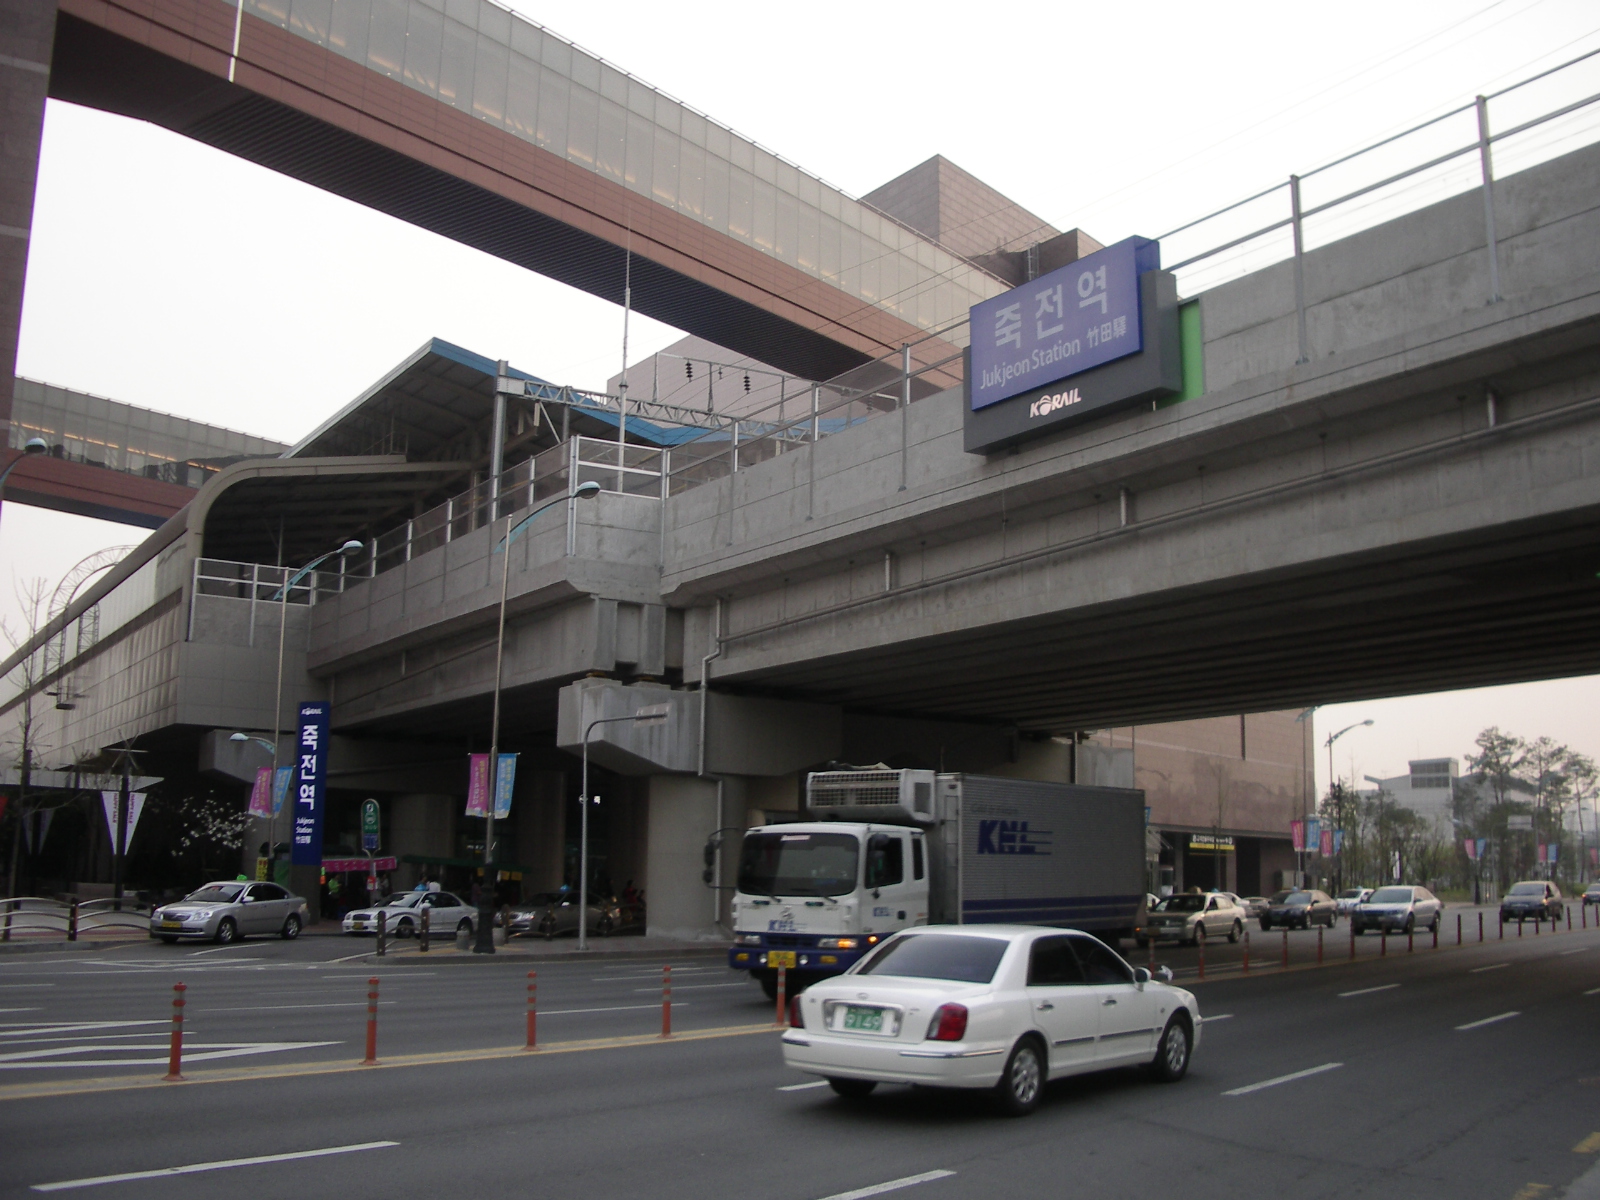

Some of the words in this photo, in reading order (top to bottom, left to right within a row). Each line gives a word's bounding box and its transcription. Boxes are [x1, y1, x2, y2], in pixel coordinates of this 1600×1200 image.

[995, 265, 1108, 349] 죽전역
[980, 358, 1030, 390] Jukjeon
[1031, 339, 1081, 370] Station
[1029, 388, 1082, 418] KORAIL
[299, 724, 319, 811] 죽전역
[295, 826, 313, 834] Station
[296, 817, 315, 826] Jukjeon
